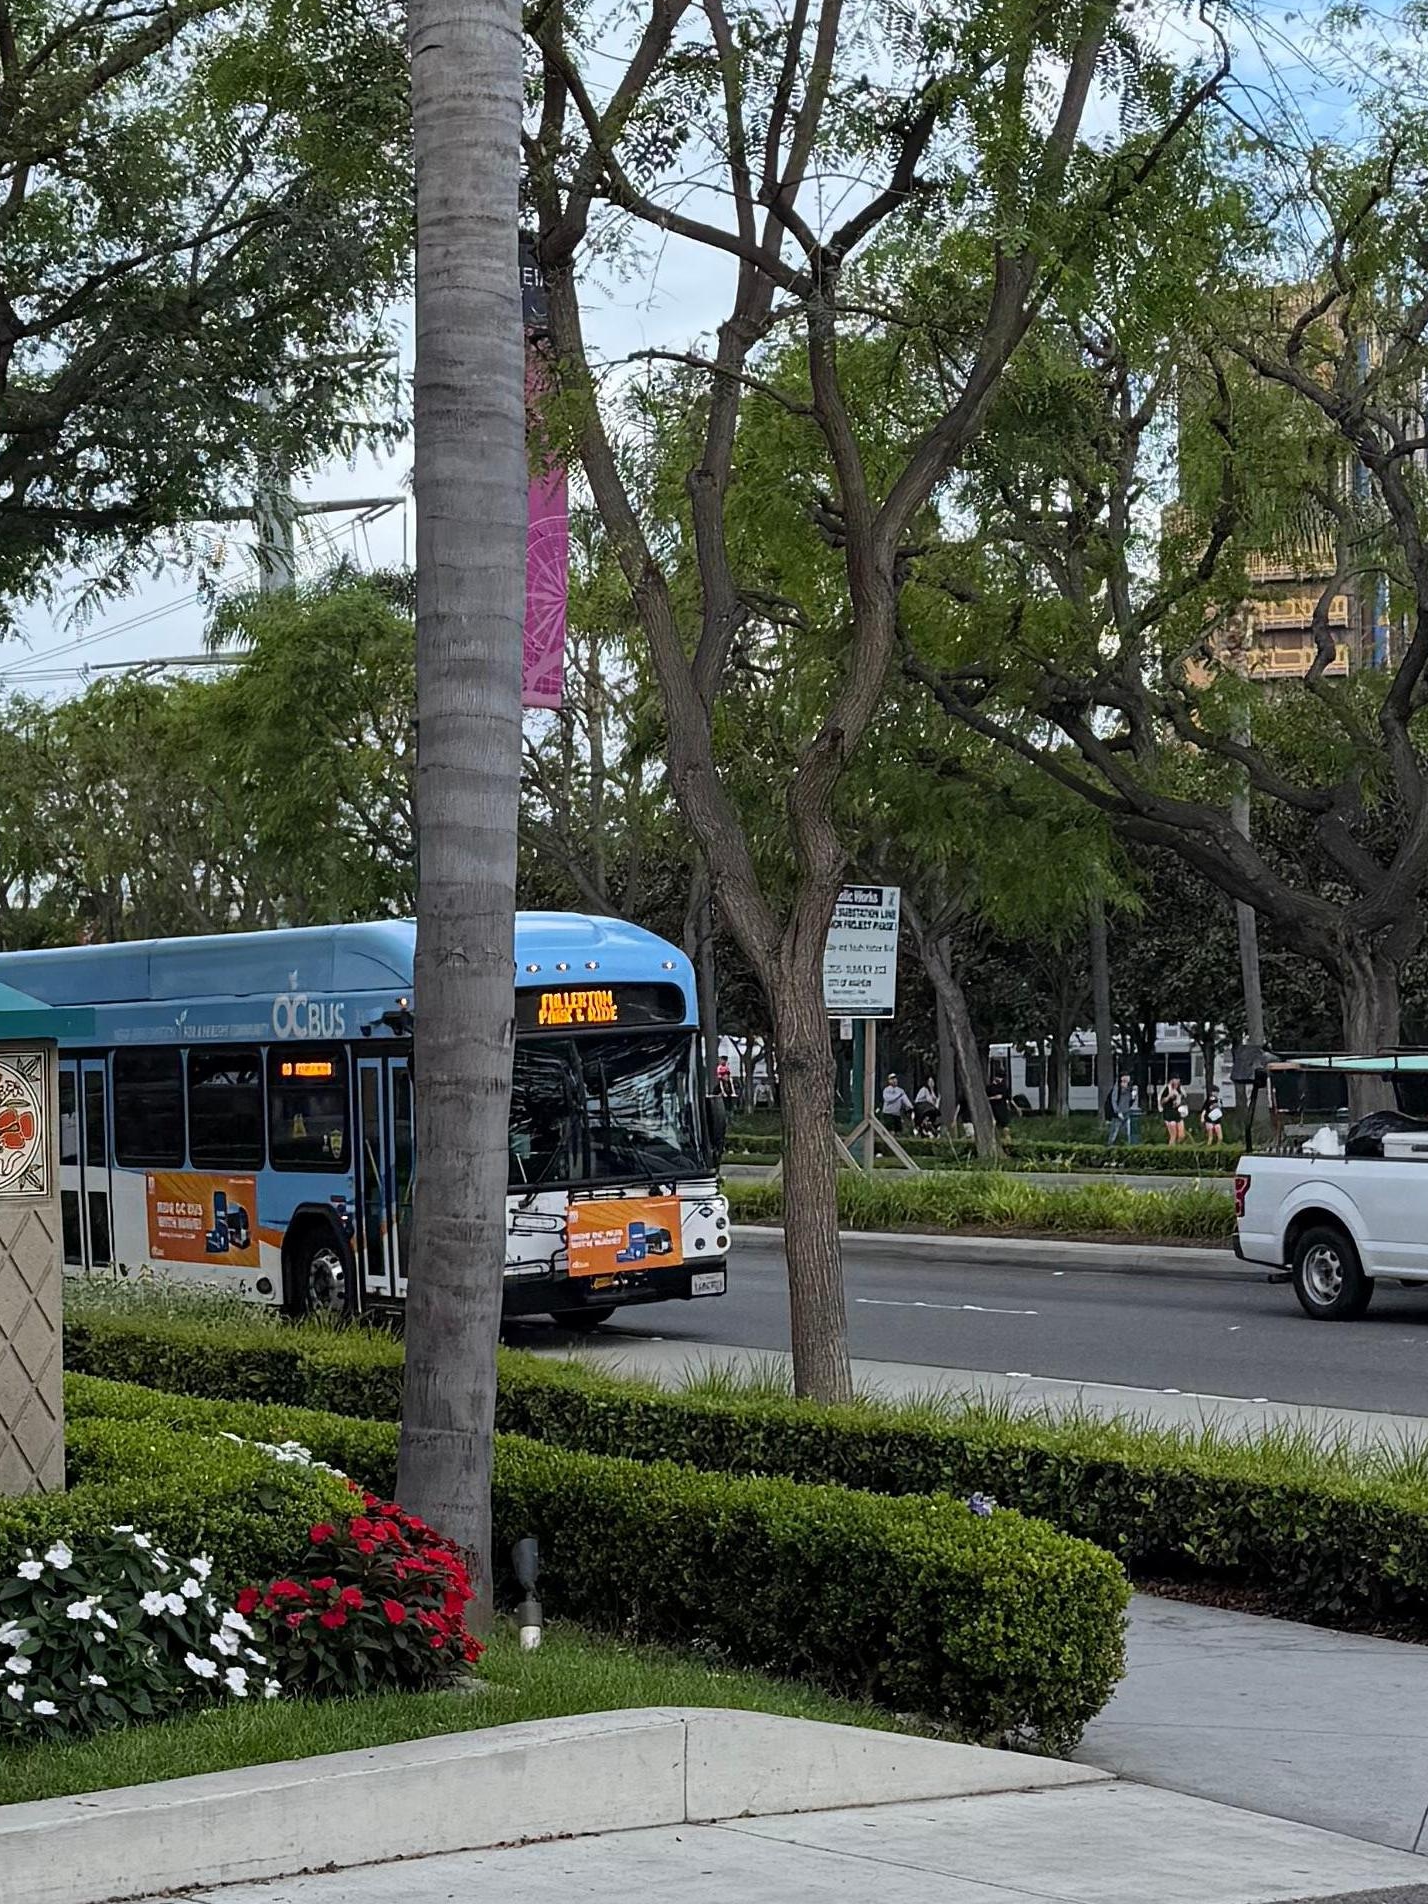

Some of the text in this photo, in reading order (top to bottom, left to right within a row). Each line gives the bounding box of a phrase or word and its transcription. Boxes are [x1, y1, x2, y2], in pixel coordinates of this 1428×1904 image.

[854, 890, 878, 903] Works
[541, 990, 613, 1009] FULLERTON
[587, 1004, 618, 1022] RIDE
